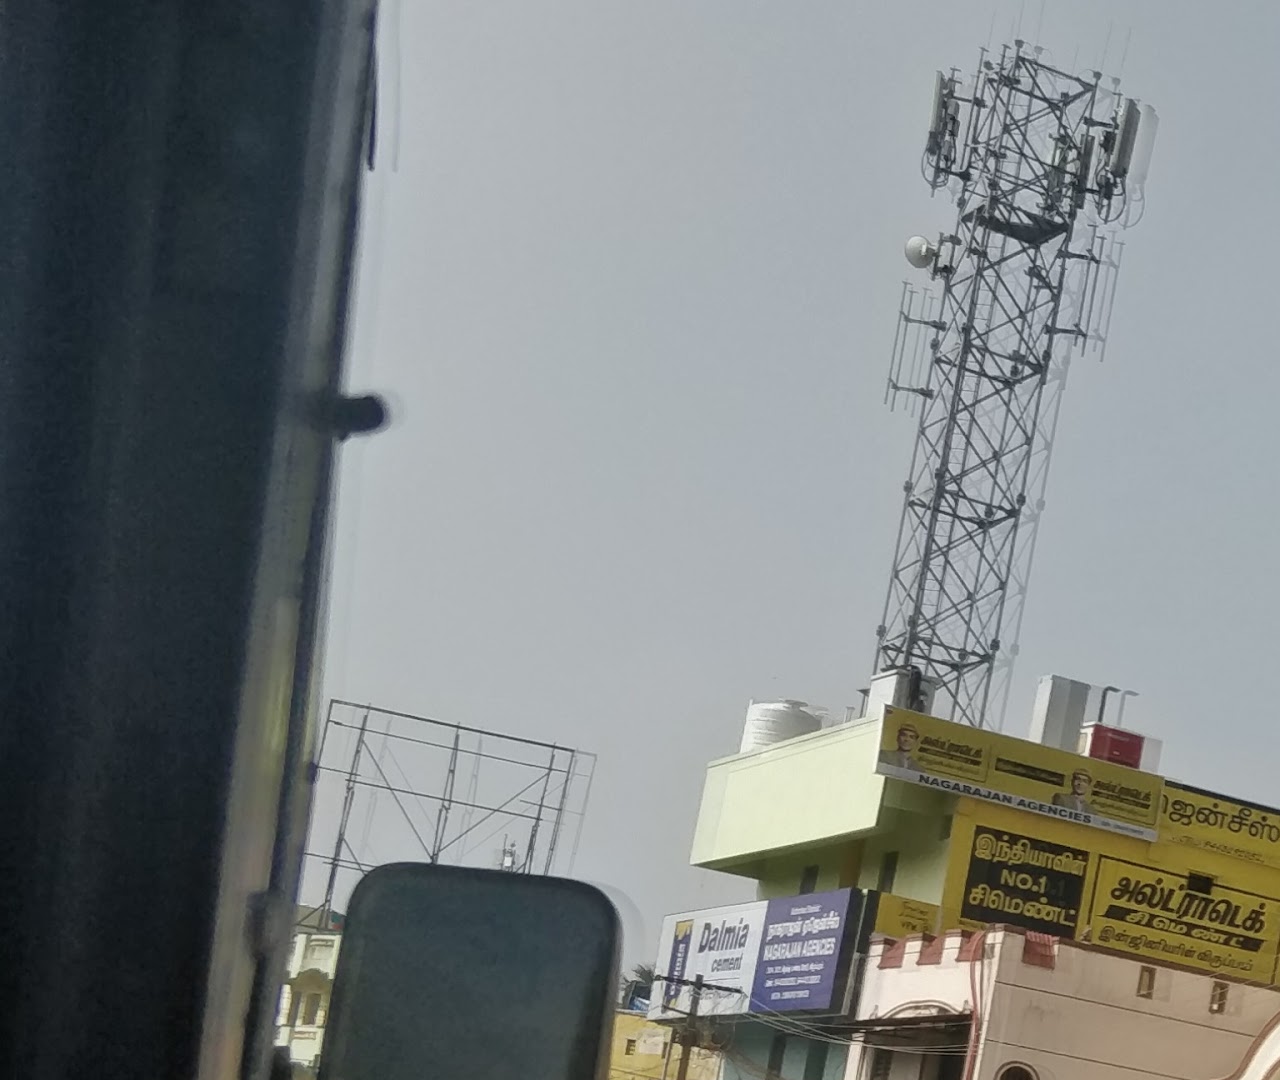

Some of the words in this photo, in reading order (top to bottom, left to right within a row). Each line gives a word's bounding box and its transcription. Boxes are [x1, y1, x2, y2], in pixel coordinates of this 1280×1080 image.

[918, 773, 1013, 805] NAGARAJAN
[1016, 798, 1092, 824] AGENCIES
[974, 831, 1088, 877] இந்தியாவின்
[968, 883, 1078, 928] சிமெண்ட்
[1110, 875, 1267, 935] அல்ட்ராடெக்
[698, 917, 750, 953] Dalmia
[763, 941, 802, 962] NAGARAJAN
[802, 937, 836, 957] AGENCIES
[711, 955, 744, 973] cement
